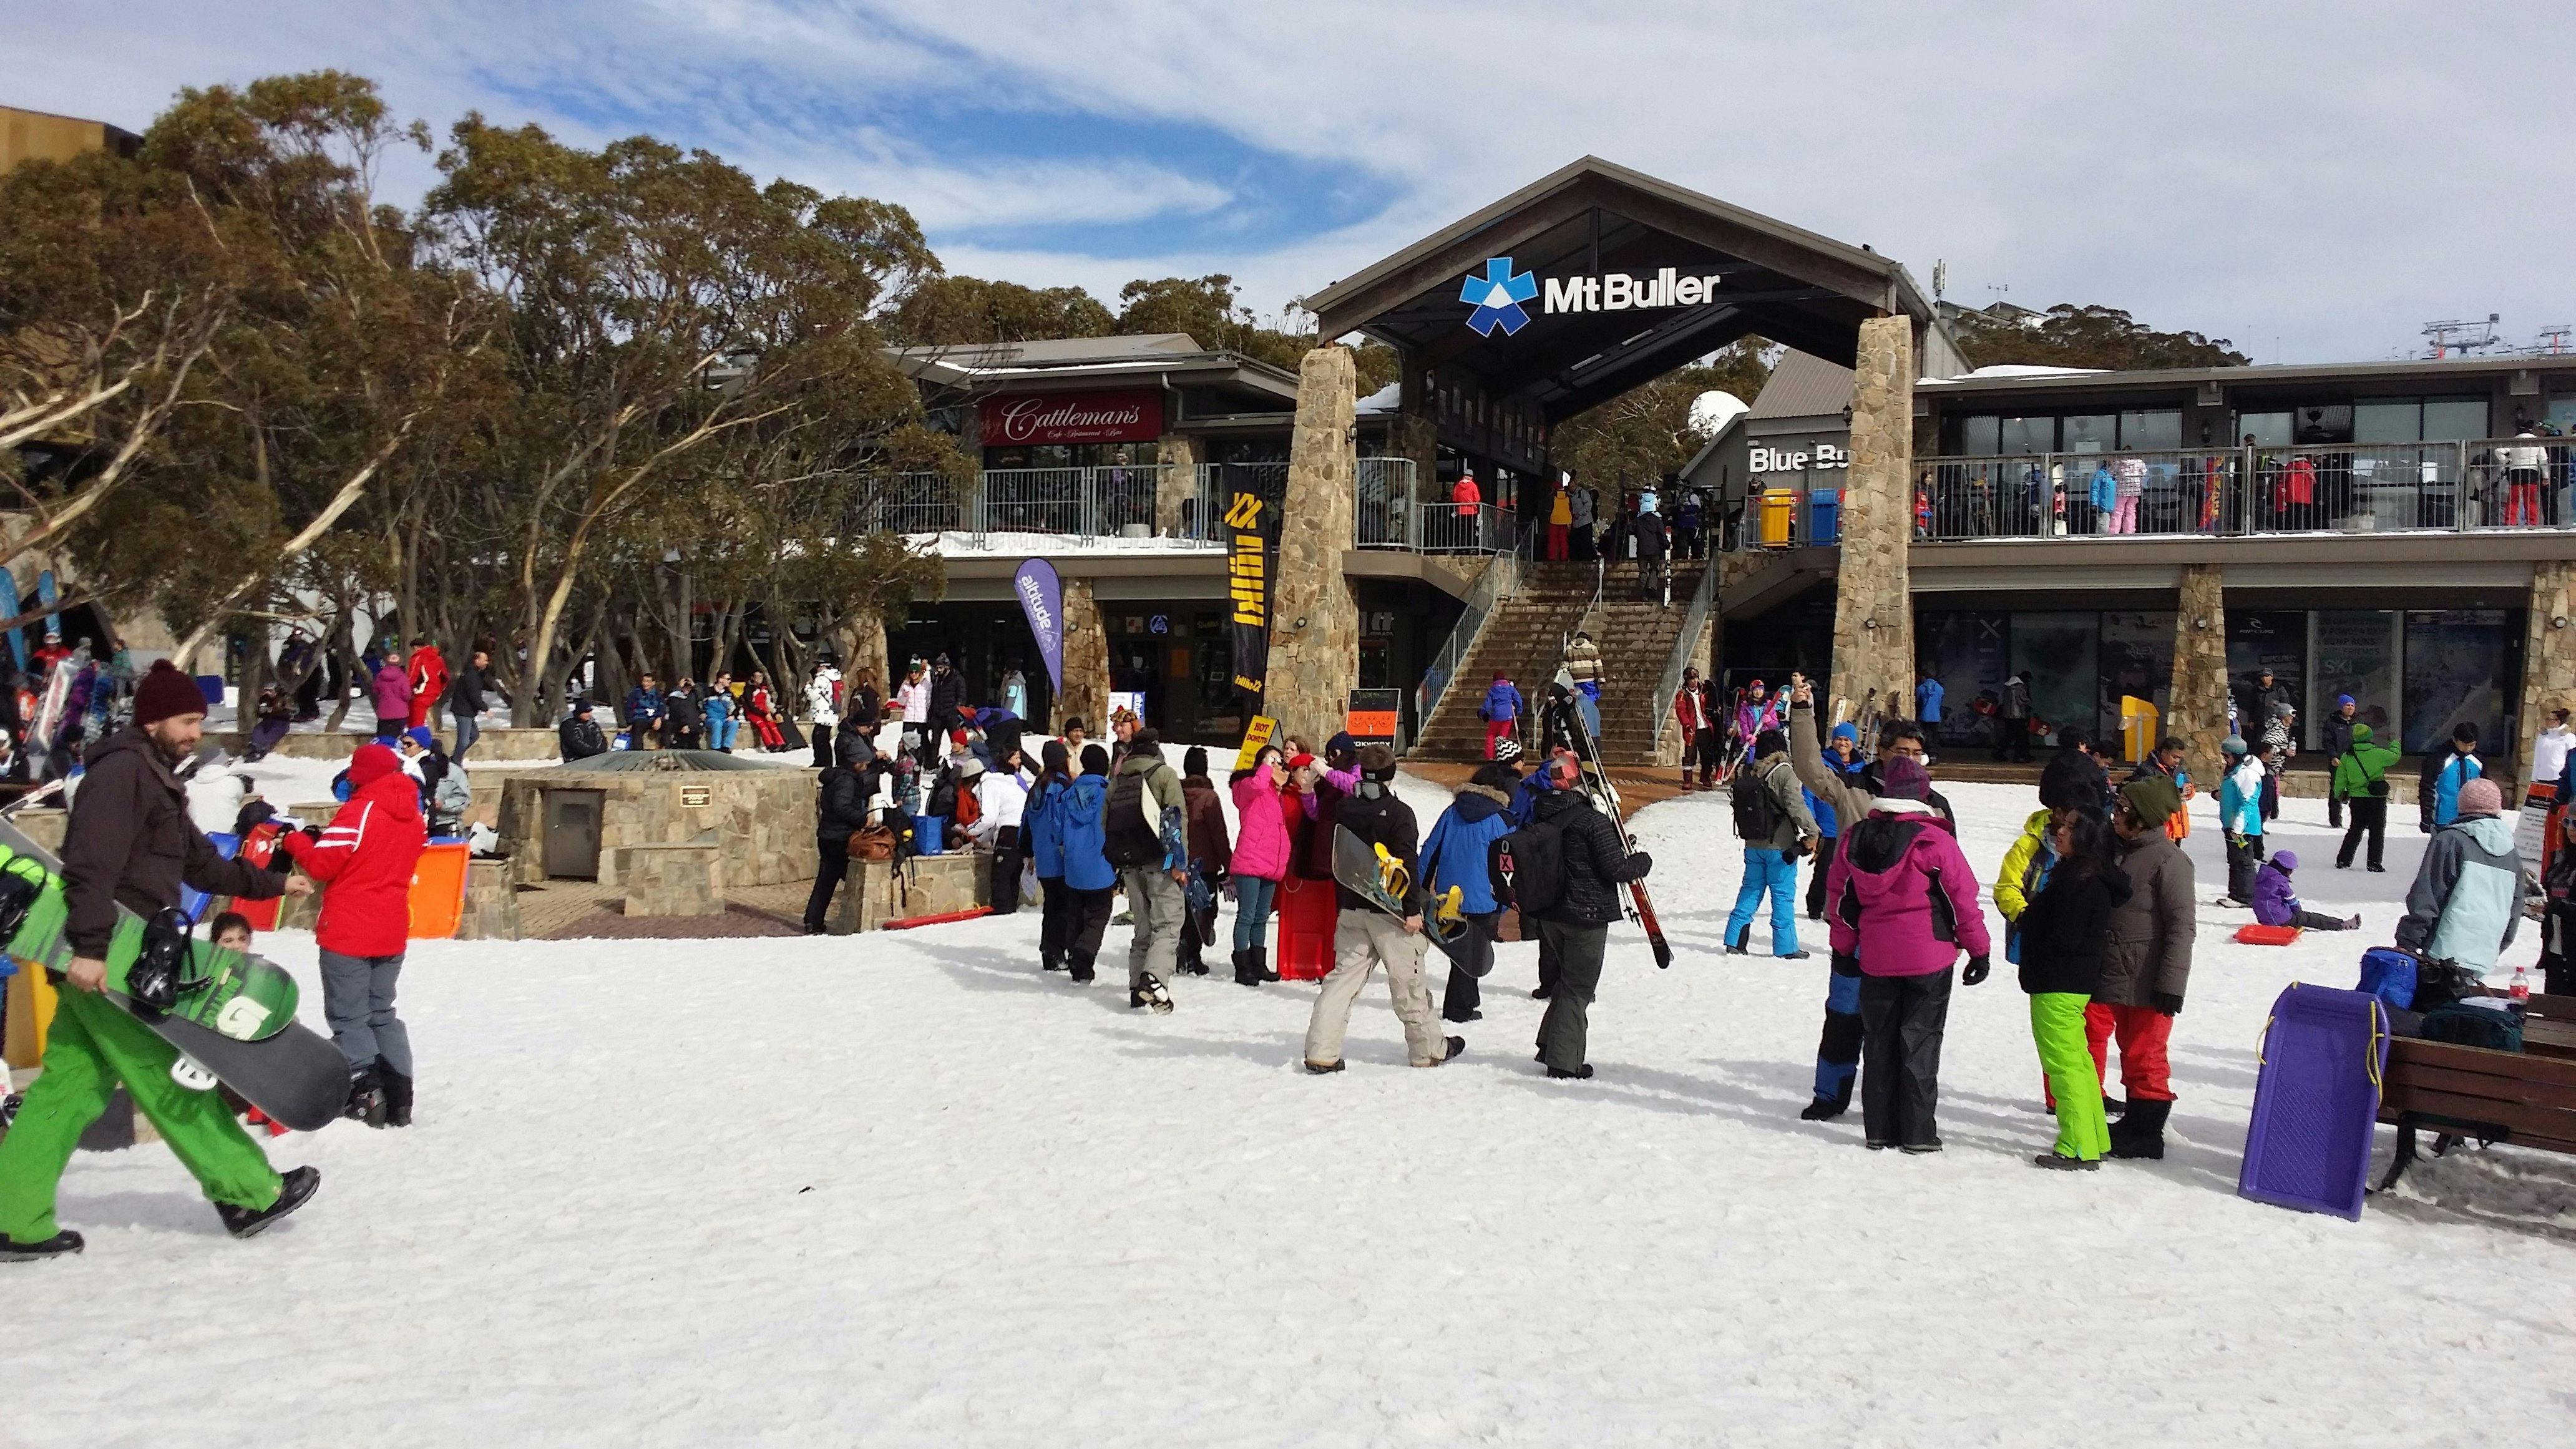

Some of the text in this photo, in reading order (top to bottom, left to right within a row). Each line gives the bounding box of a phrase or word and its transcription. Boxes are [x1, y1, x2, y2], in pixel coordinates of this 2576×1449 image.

[1544, 266, 1721, 314] Mt Buller
[1001, 399, 1140, 441] Cattleman's
[1749, 447, 1810, 473] Blue
[1021, 575, 1052, 630] altitude
[1246, 734, 1268, 744] DONUTS
[1254, 722, 1270, 733] HOT
